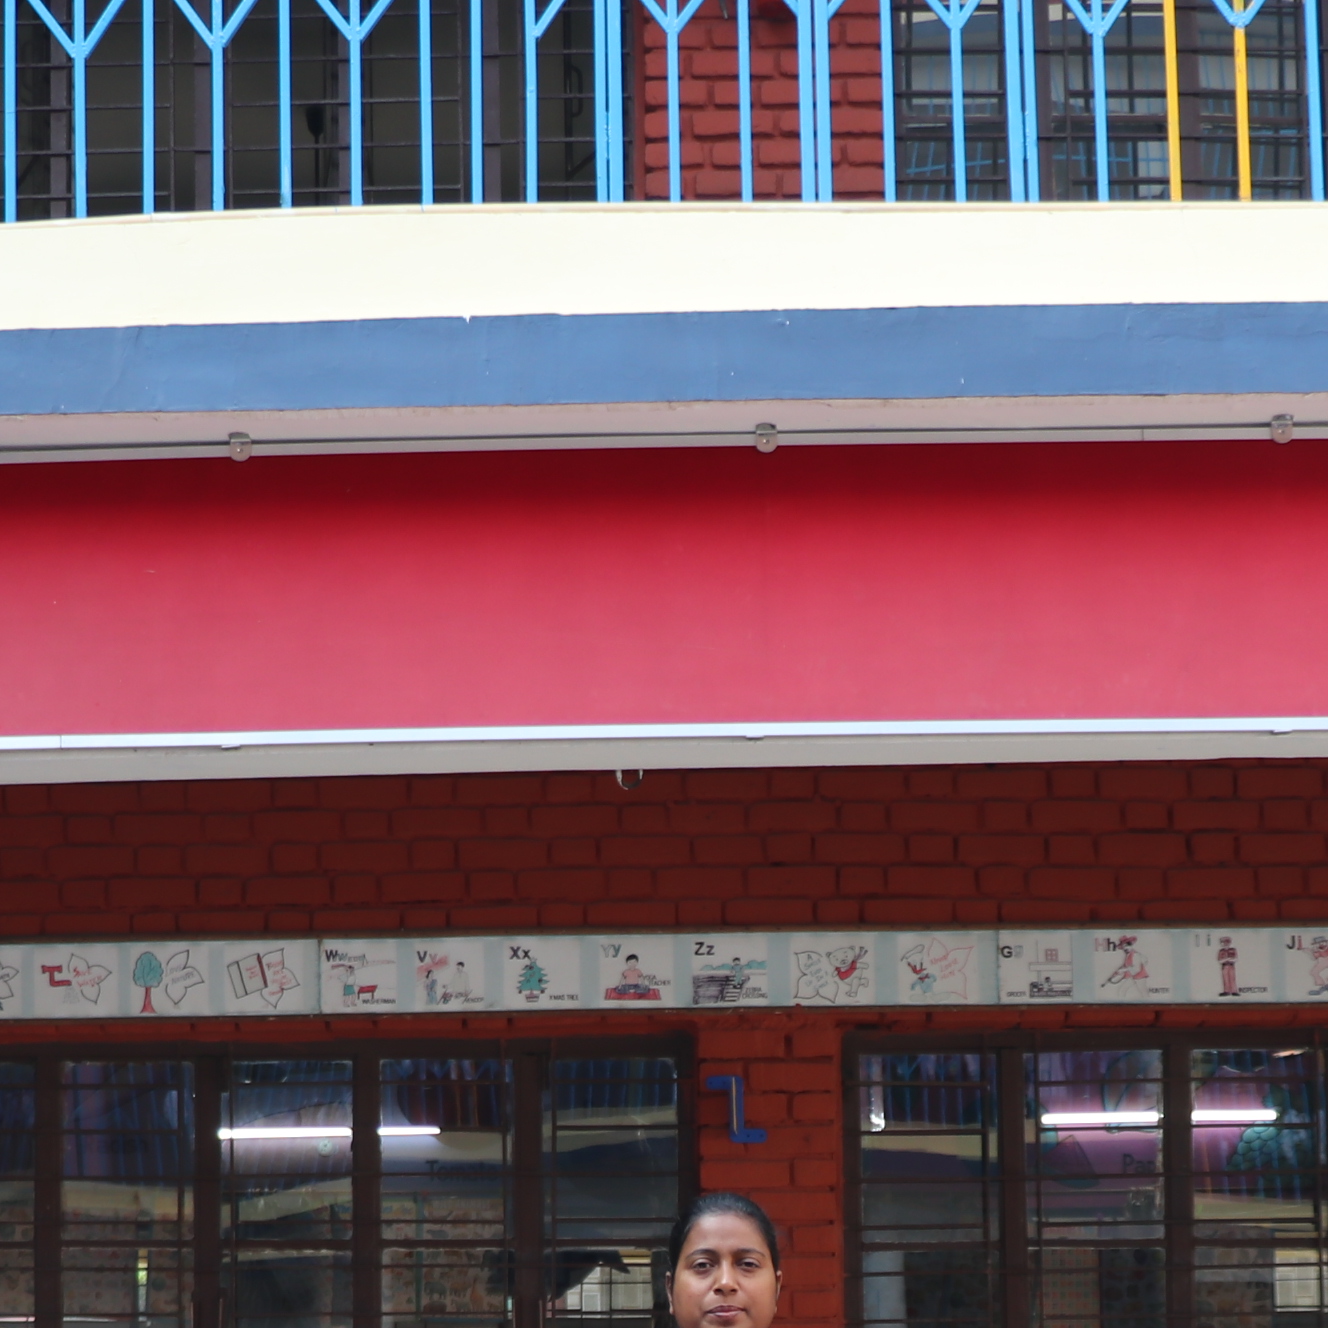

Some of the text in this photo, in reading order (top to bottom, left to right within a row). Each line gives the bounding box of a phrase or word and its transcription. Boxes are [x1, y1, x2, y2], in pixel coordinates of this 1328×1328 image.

[601, 944, 622, 958] Yy
[694, 942, 715, 956] Zz
[1095, 937, 1117, 952] Hh
[510, 946, 531, 960] Xx
